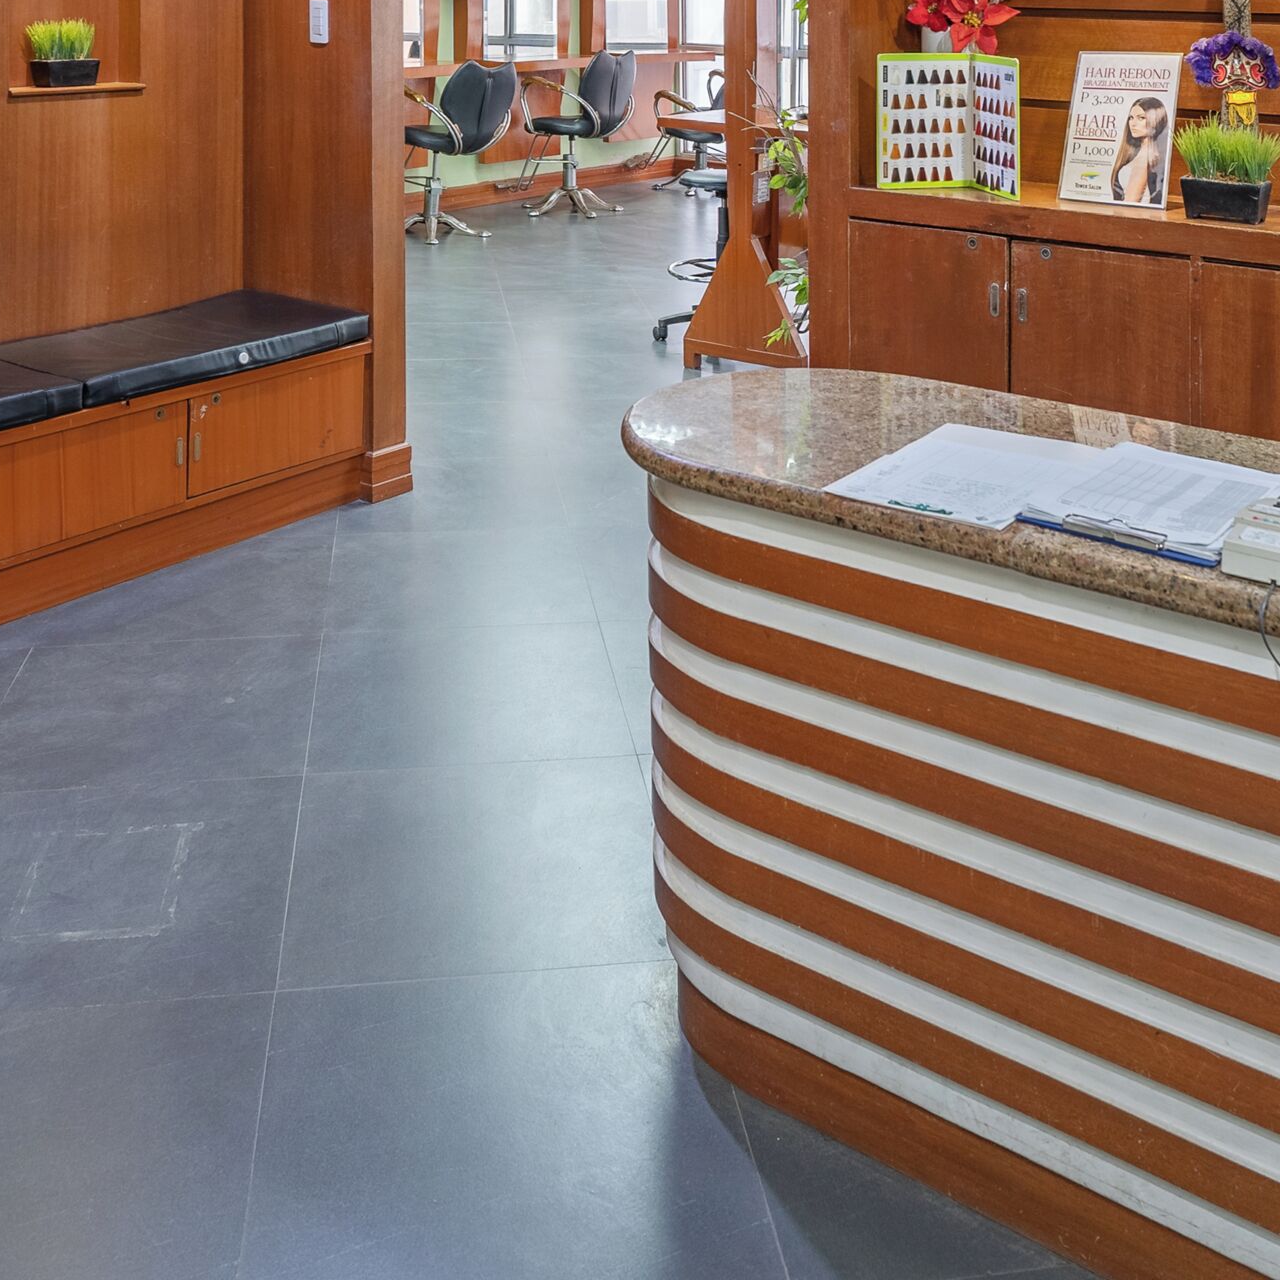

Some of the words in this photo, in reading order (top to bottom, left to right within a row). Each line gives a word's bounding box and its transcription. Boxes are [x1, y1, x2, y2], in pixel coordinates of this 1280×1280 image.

[1085, 67, 1116, 79] HAIR
[1119, 68, 1171, 80] REBOND
[1124, 81, 1170, 89] TREATMENT
[1080, 92, 1090, 103] P
[1091, 96, 1124, 106] 3,200
[1075, 114, 1116, 129] HAIR
[1074, 128, 1118, 138] REBOND
[1072, 142, 1081, 154] P
[1084, 147, 1115, 157] 1,000
